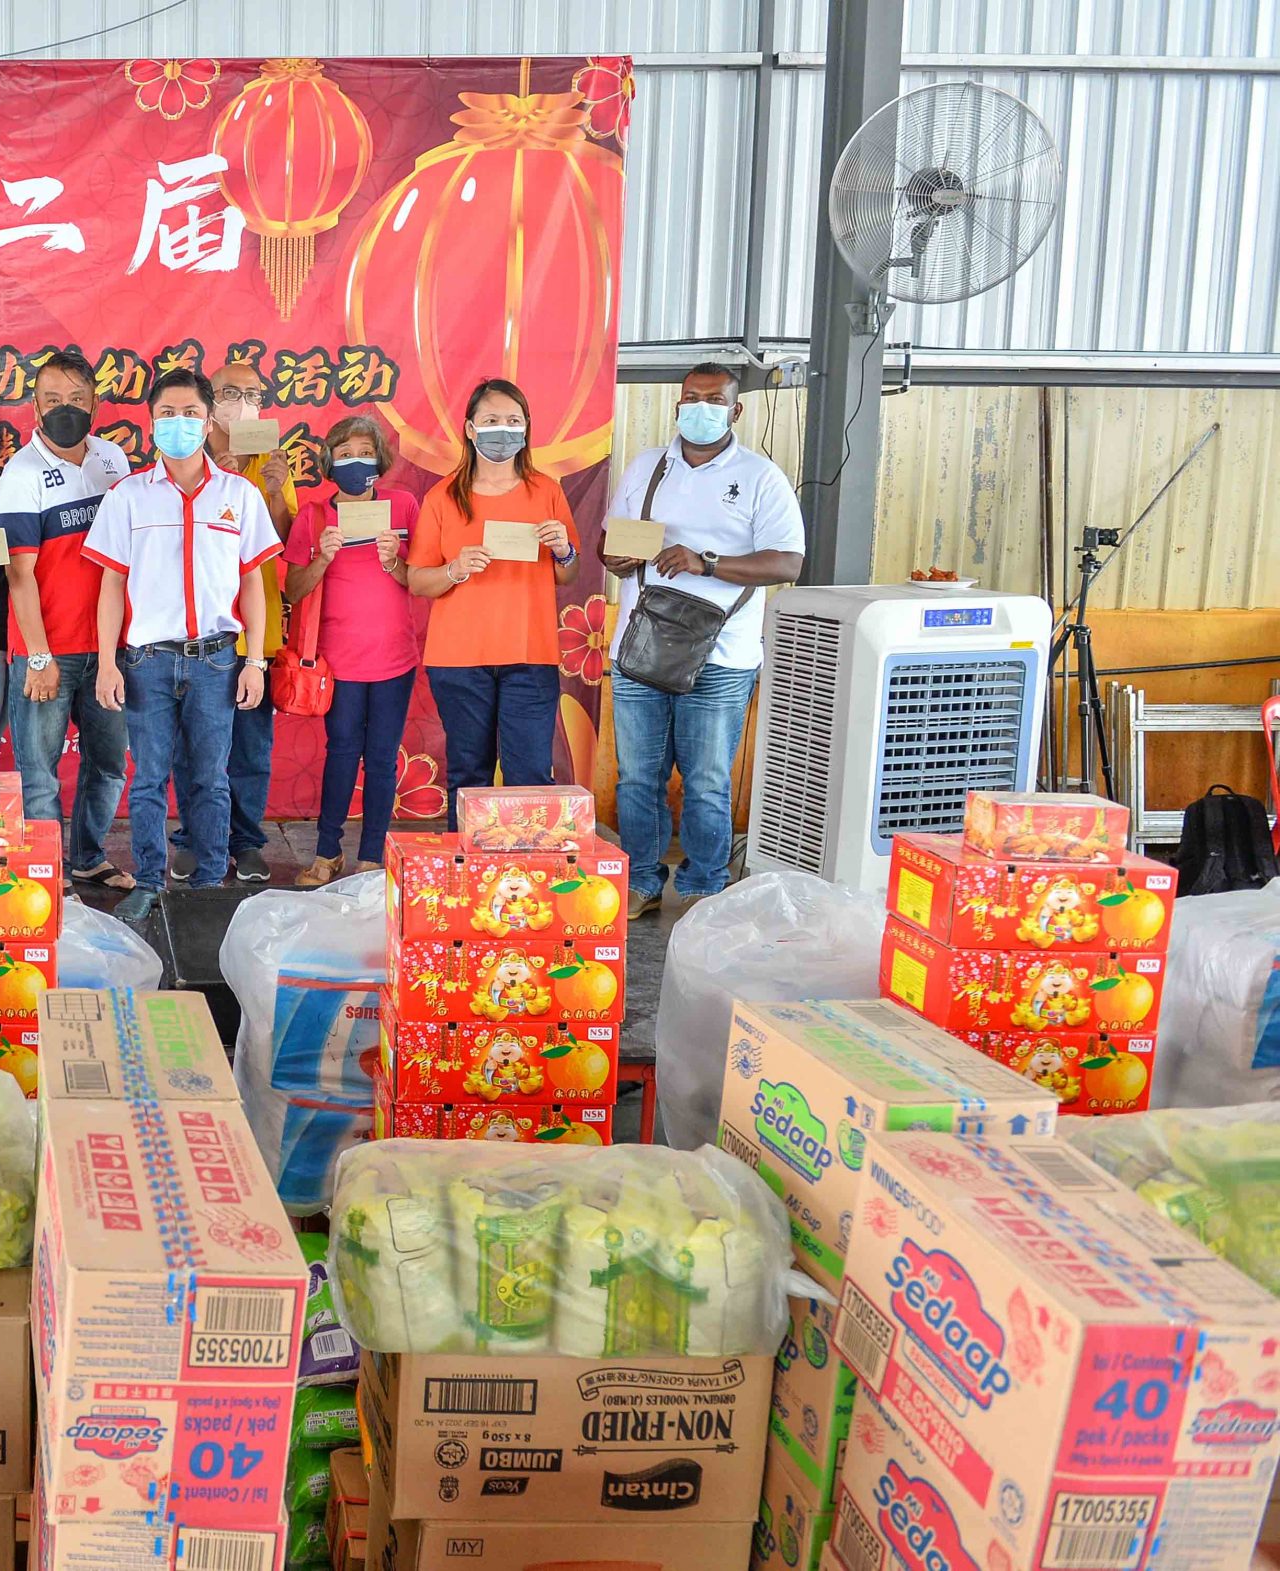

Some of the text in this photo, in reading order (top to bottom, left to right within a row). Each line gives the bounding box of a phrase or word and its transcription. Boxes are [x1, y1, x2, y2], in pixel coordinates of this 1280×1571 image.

[42, 468, 66, 489] 28
[30, 866, 51, 875] NSK
[599, 862, 621, 872] NSK
[1148, 877, 1169, 887] NSK
[26, 950, 46, 959] NSK
[597, 948, 618, 958] NSK
[1139, 961, 1159, 969] NSK
[590, 1028, 611, 1038] NSK
[1130, 1041, 1151, 1049] NSK
[773, 1096, 785, 1110] Mi
[583, 1109, 605, 1119] NSK
[750, 1092, 833, 1170] Sedaap
[871, 1160, 945, 1236] WINGSFOOD
[785, 1194, 822, 1233] Mi Sup
[923, 1267, 942, 1289] Mi
[847, 1287, 890, 1350] 17005355
[884, 1254, 1011, 1395] Sedaap
[195, 1338, 284, 1363] 17005355
[687, 1377, 720, 1388] TANPA
[723, 1373, 738, 1385] MI
[602, 1394, 736, 1407] ORIGINAL NOODLES (JUMBO)
[1093, 1379, 1171, 1421] 40
[184, 1415, 277, 1435] pek packs
[581, 1408, 735, 1442] NON-FRIED
[915, 1388, 965, 1455] GORENG
[66, 1424, 168, 1444] Sedaap
[482, 1430, 489, 1440] g
[491, 1433, 512, 1443] 550
[524, 1433, 531, 1443] 8
[1076, 1430, 1170, 1450] pek packs
[188, 1442, 265, 1480] 40
[485, 1451, 558, 1469] JUMBO
[185, 1487, 268, 1503] Isi Content
[488, 1479, 521, 1494] Yeo's
[608, 1480, 695, 1500] Cintan
[905, 1494, 924, 1522] Mi
[1059, 1496, 1148, 1523] 17005355
[451, 1540, 479, 1555] MY
